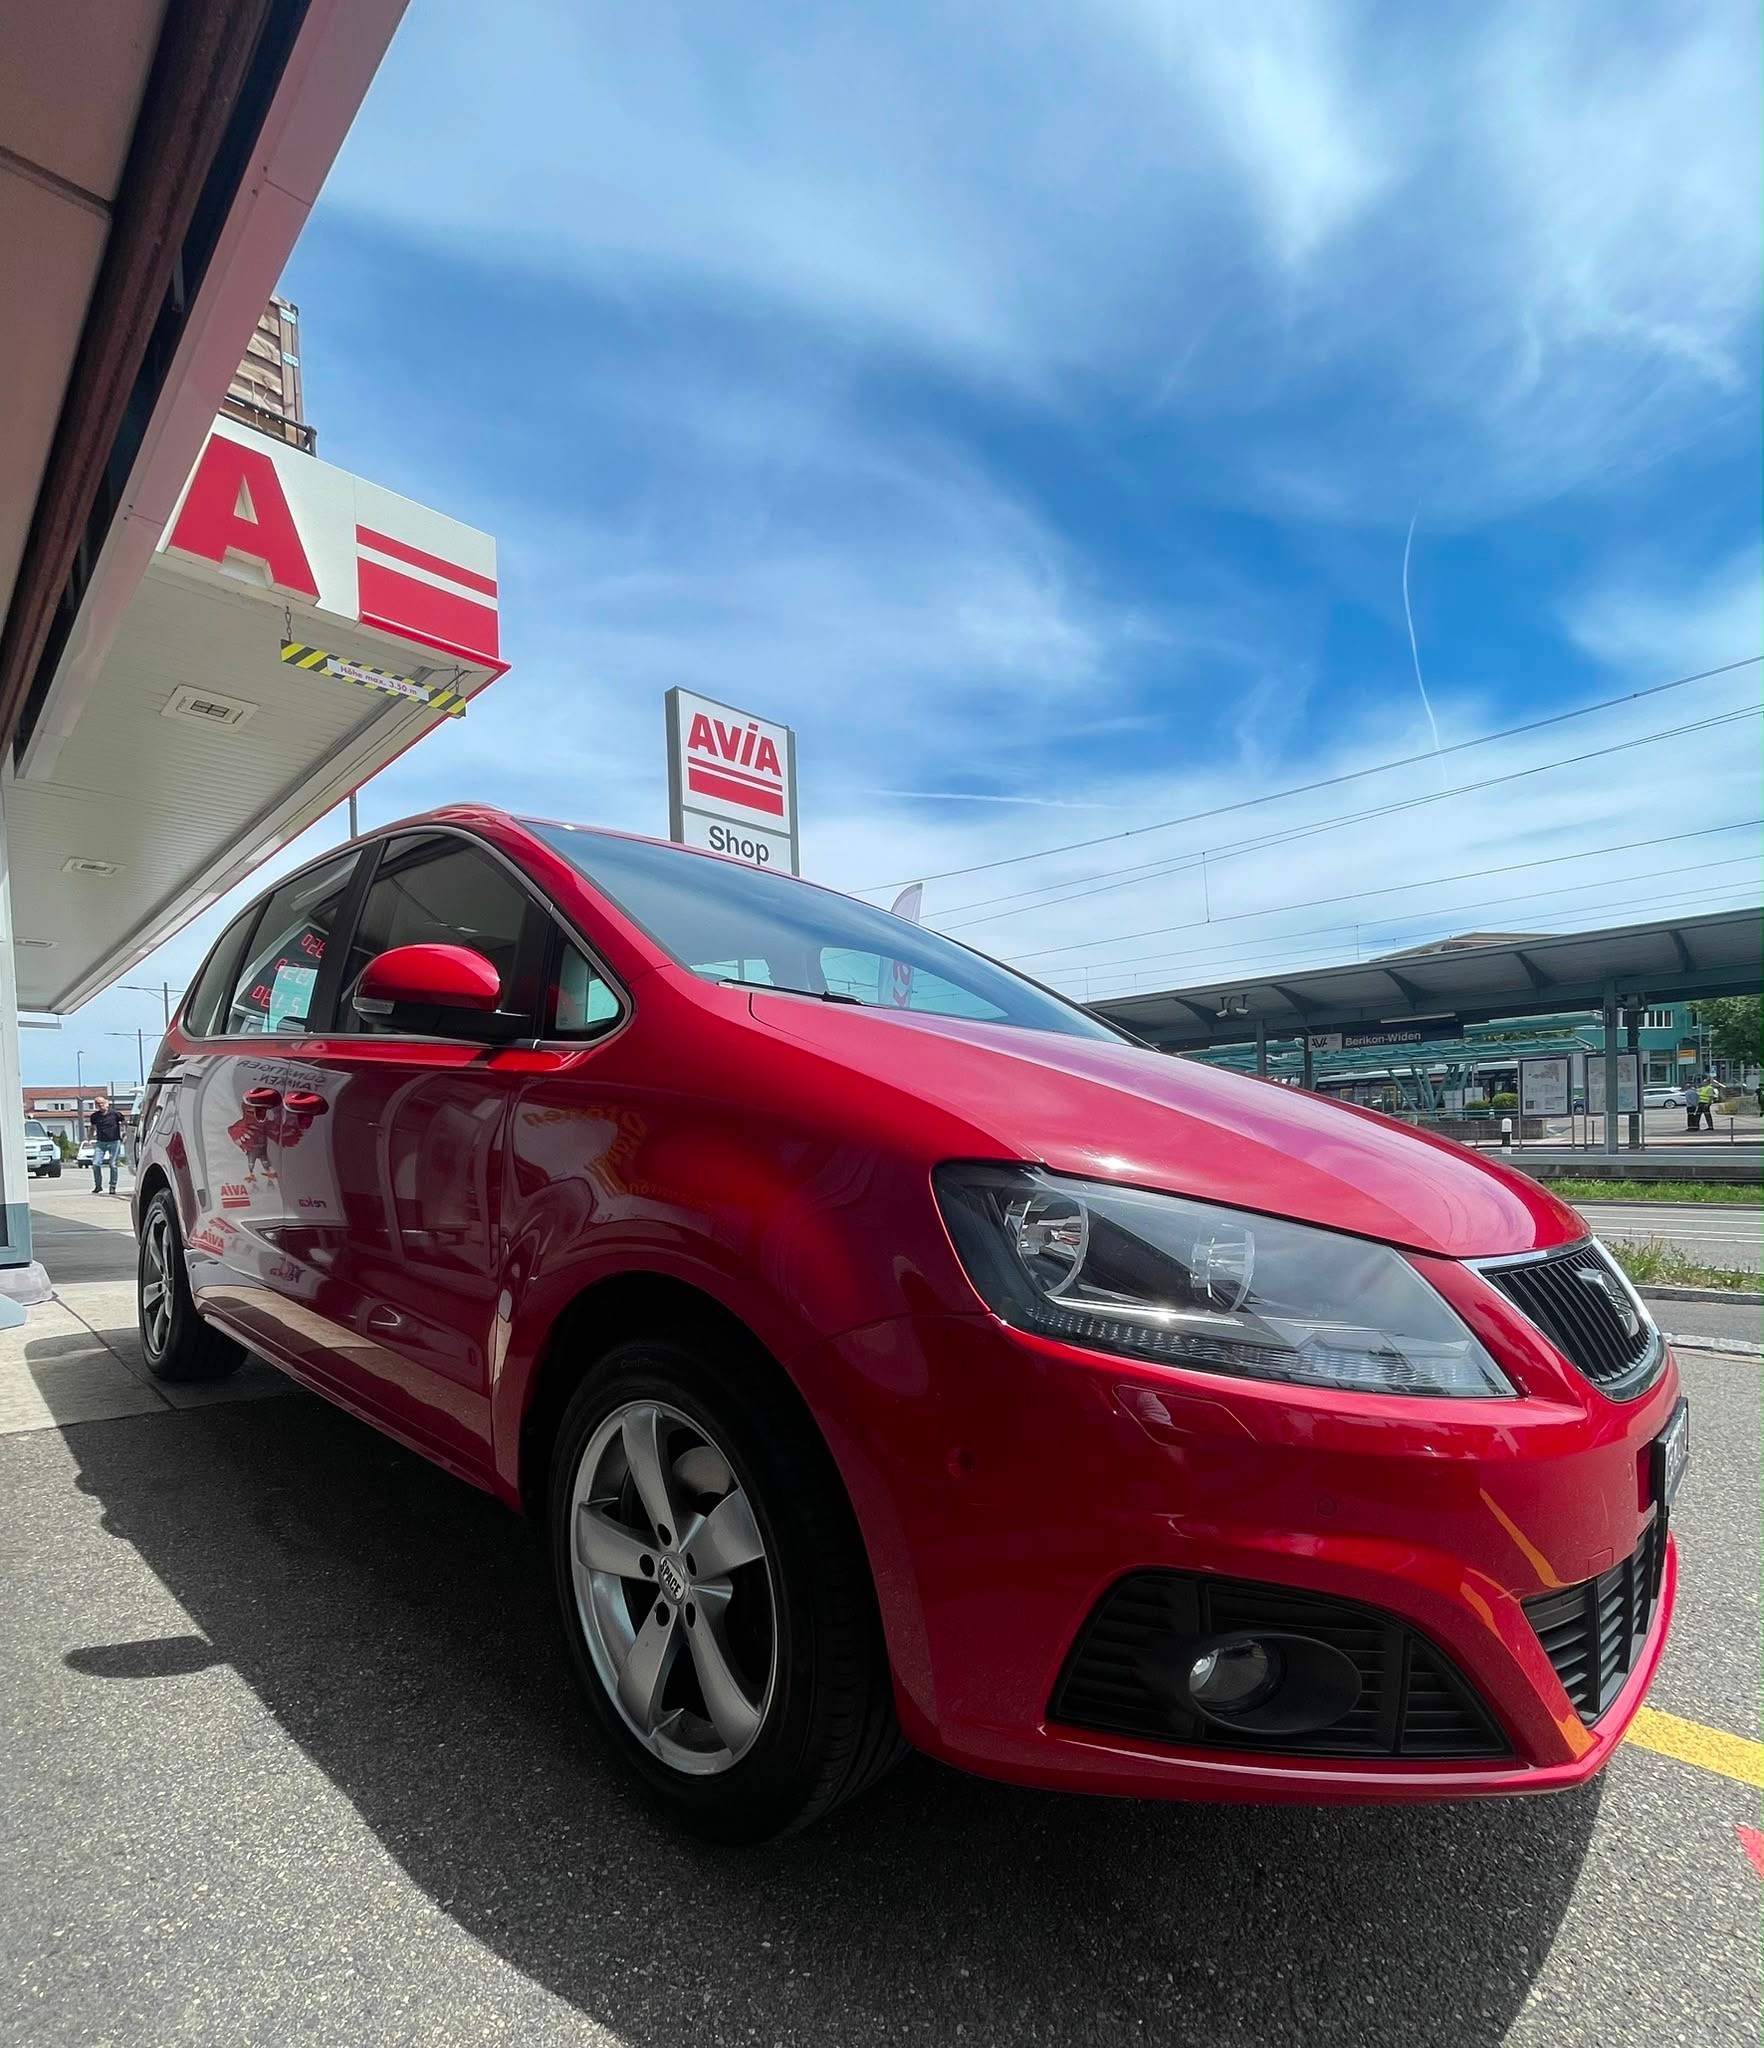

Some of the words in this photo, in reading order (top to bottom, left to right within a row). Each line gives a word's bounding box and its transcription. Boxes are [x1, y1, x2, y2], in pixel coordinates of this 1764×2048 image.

[170, 432, 321, 604] A
[340, 665, 363, 679] Höhe
[365, 675, 386, 686] max.
[388, 681, 408, 692] 3.50
[688, 713, 782, 777] AVIA
[709, 825, 769, 865] Shop
[1345, 1031, 1422, 1047] Berikon-Widen
